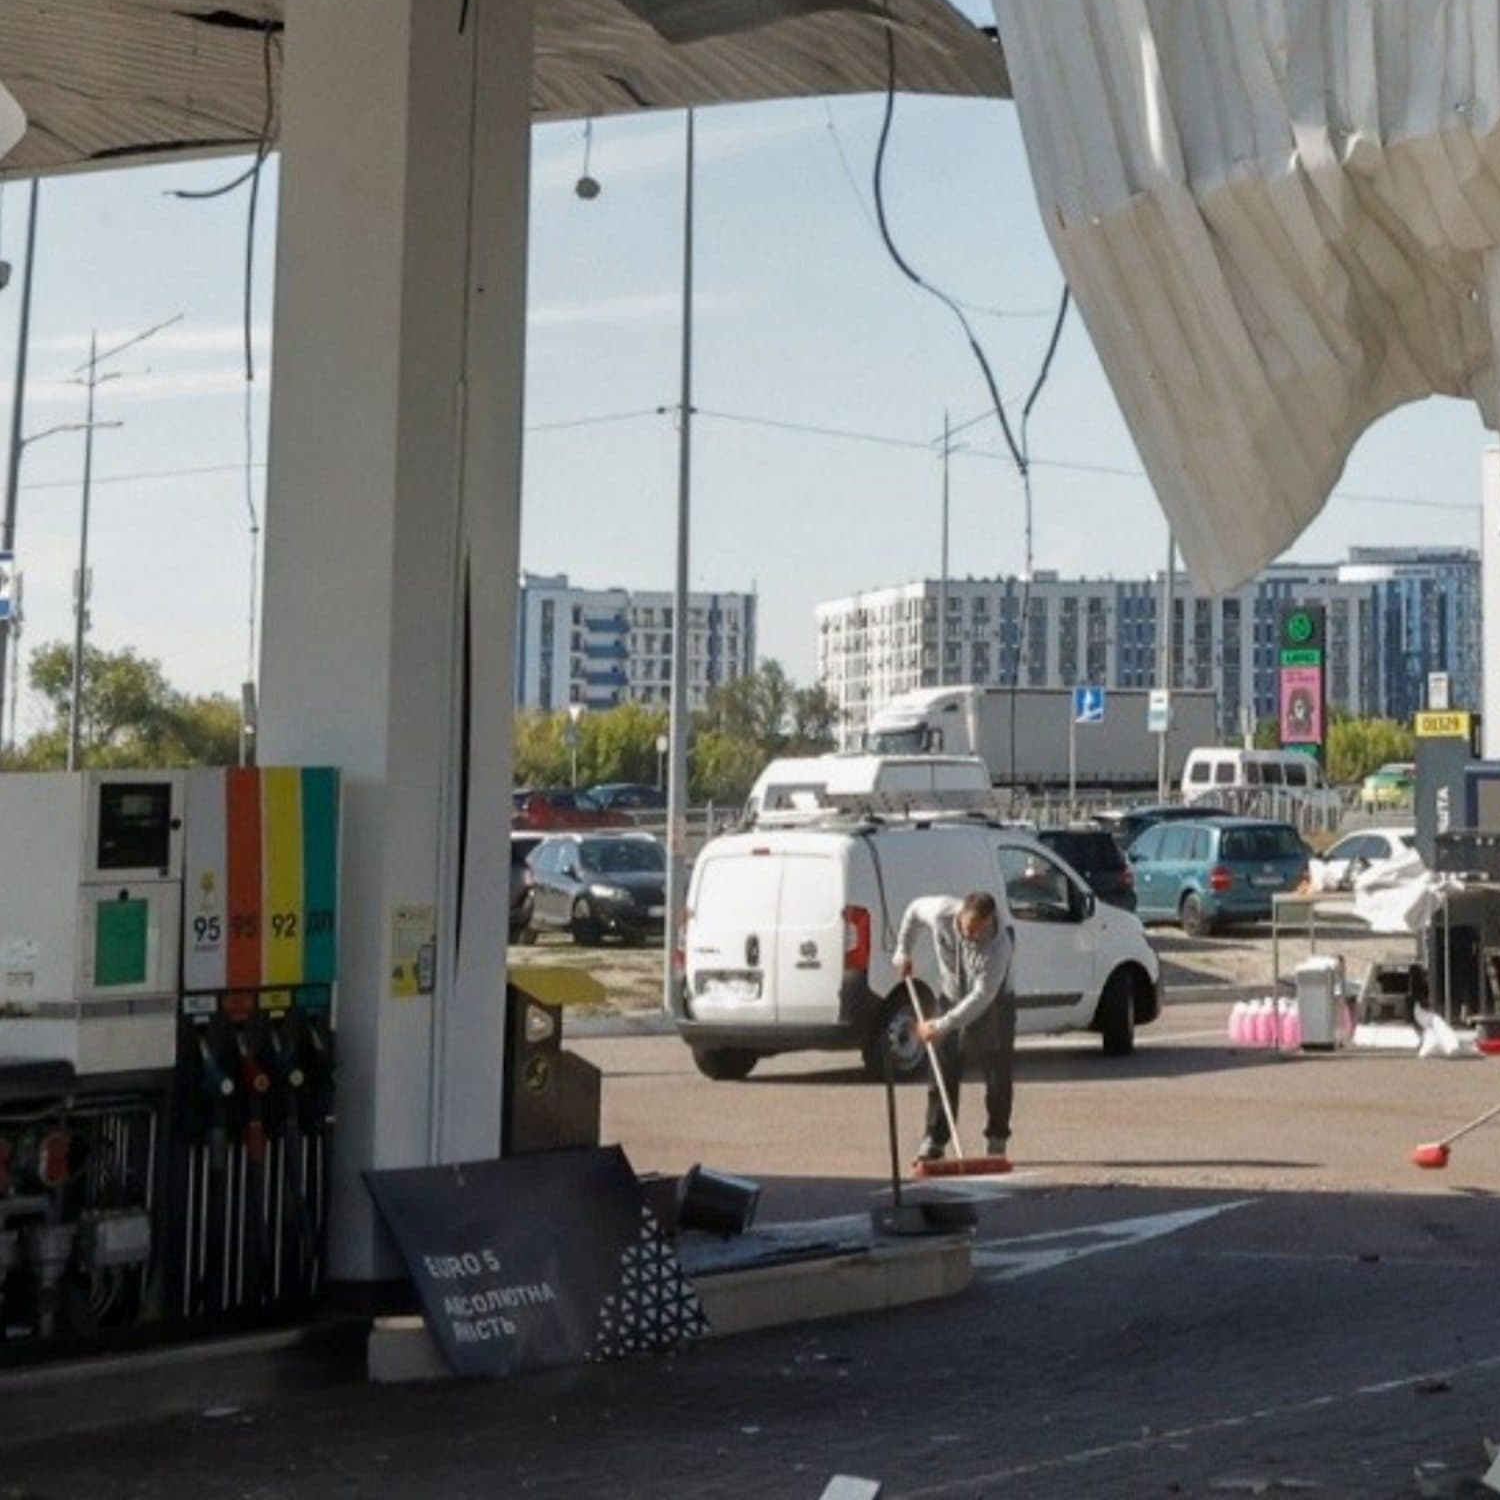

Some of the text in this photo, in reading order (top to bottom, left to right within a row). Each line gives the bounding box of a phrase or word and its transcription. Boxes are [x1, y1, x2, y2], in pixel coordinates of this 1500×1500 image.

[194, 916, 221, 942] 95
[272, 912, 297, 938] 92
[424, 1248, 501, 1280] EURO 5
